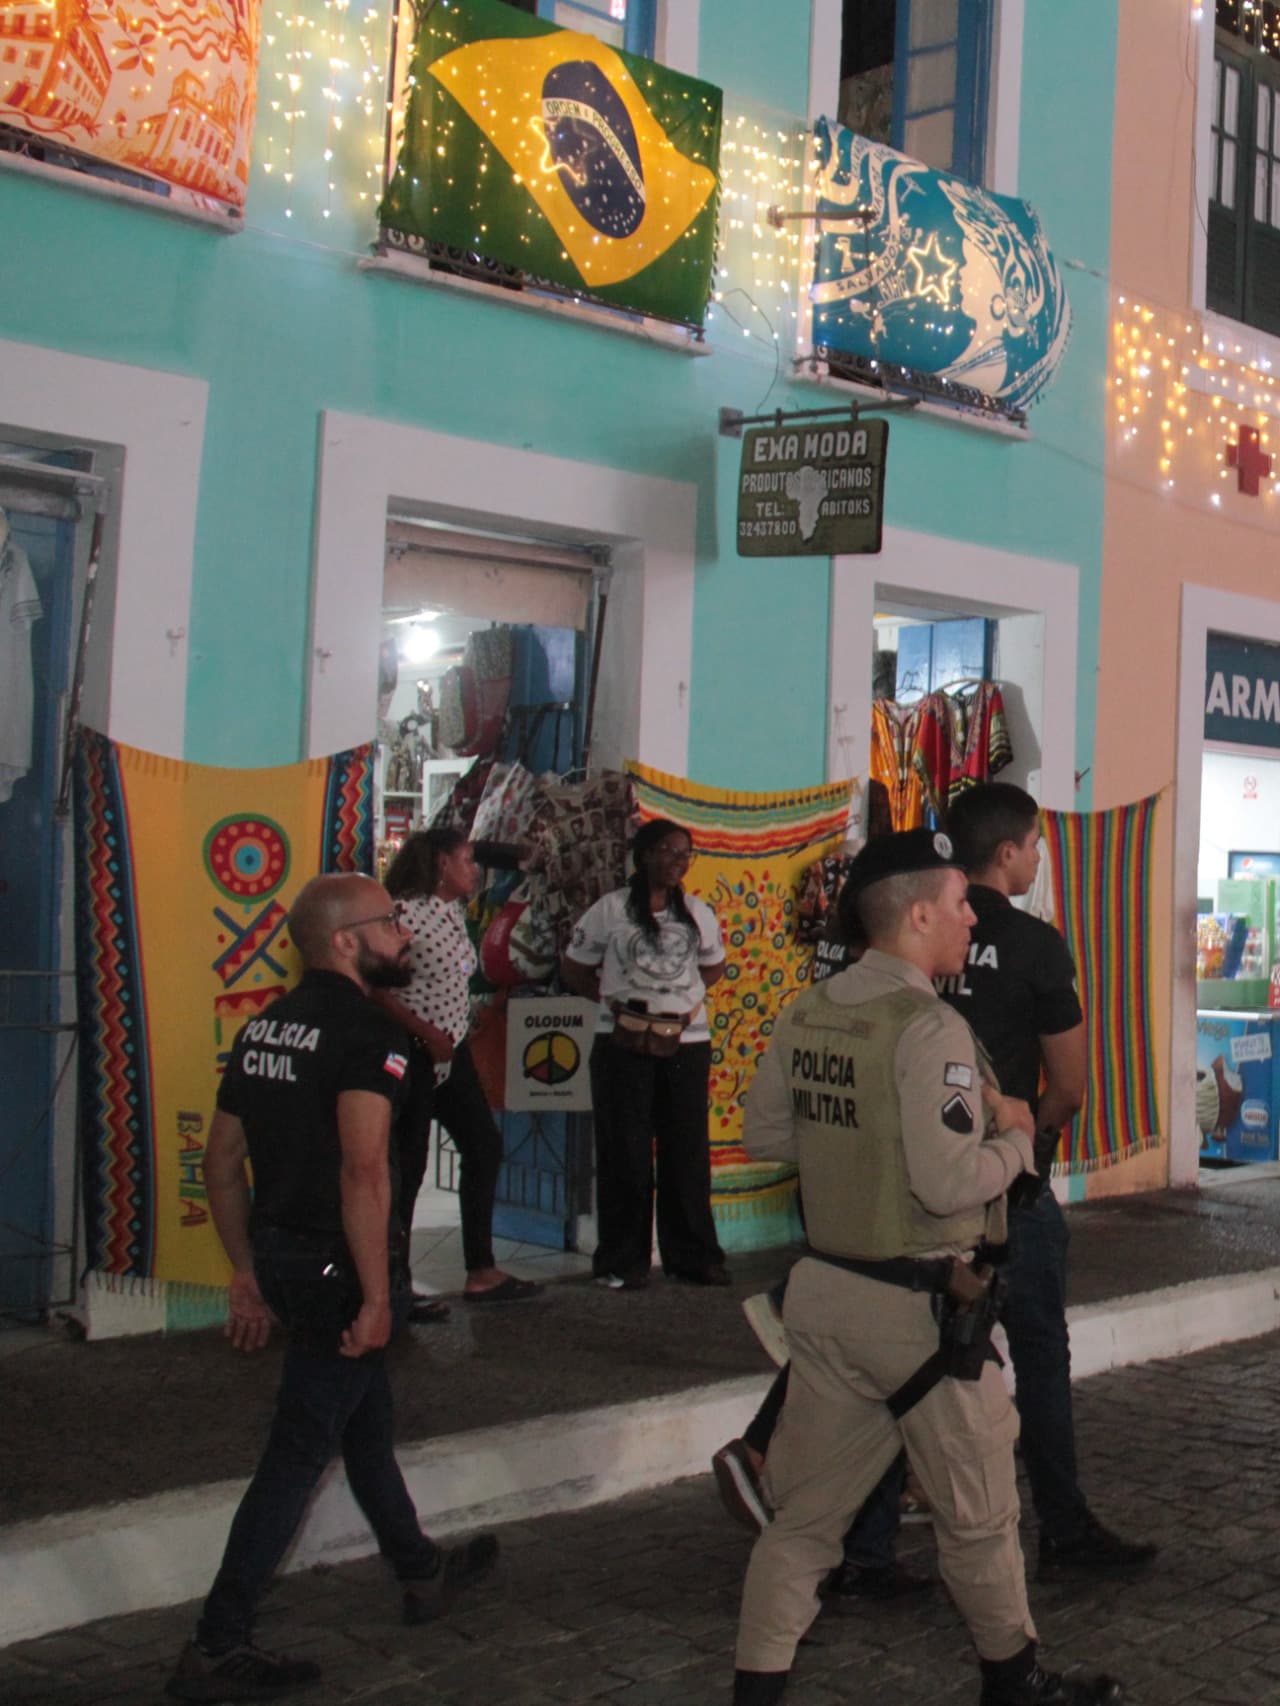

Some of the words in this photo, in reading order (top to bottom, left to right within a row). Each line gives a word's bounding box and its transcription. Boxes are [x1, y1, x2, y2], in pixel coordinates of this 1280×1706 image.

[803, 430, 867, 459] MODA
[756, 502, 785, 517] TEL:
[934, 972, 973, 996] VIL
[242, 1018, 321, 1052] POLÍCIA
[524, 1015, 584, 1028] OLODUM
[242, 1049, 297, 1082] CIVIL
[791, 1047, 856, 1089] POLÍCIA
[792, 1088, 859, 1129] MILITAR
[178, 1112, 208, 1228] BAHIA
